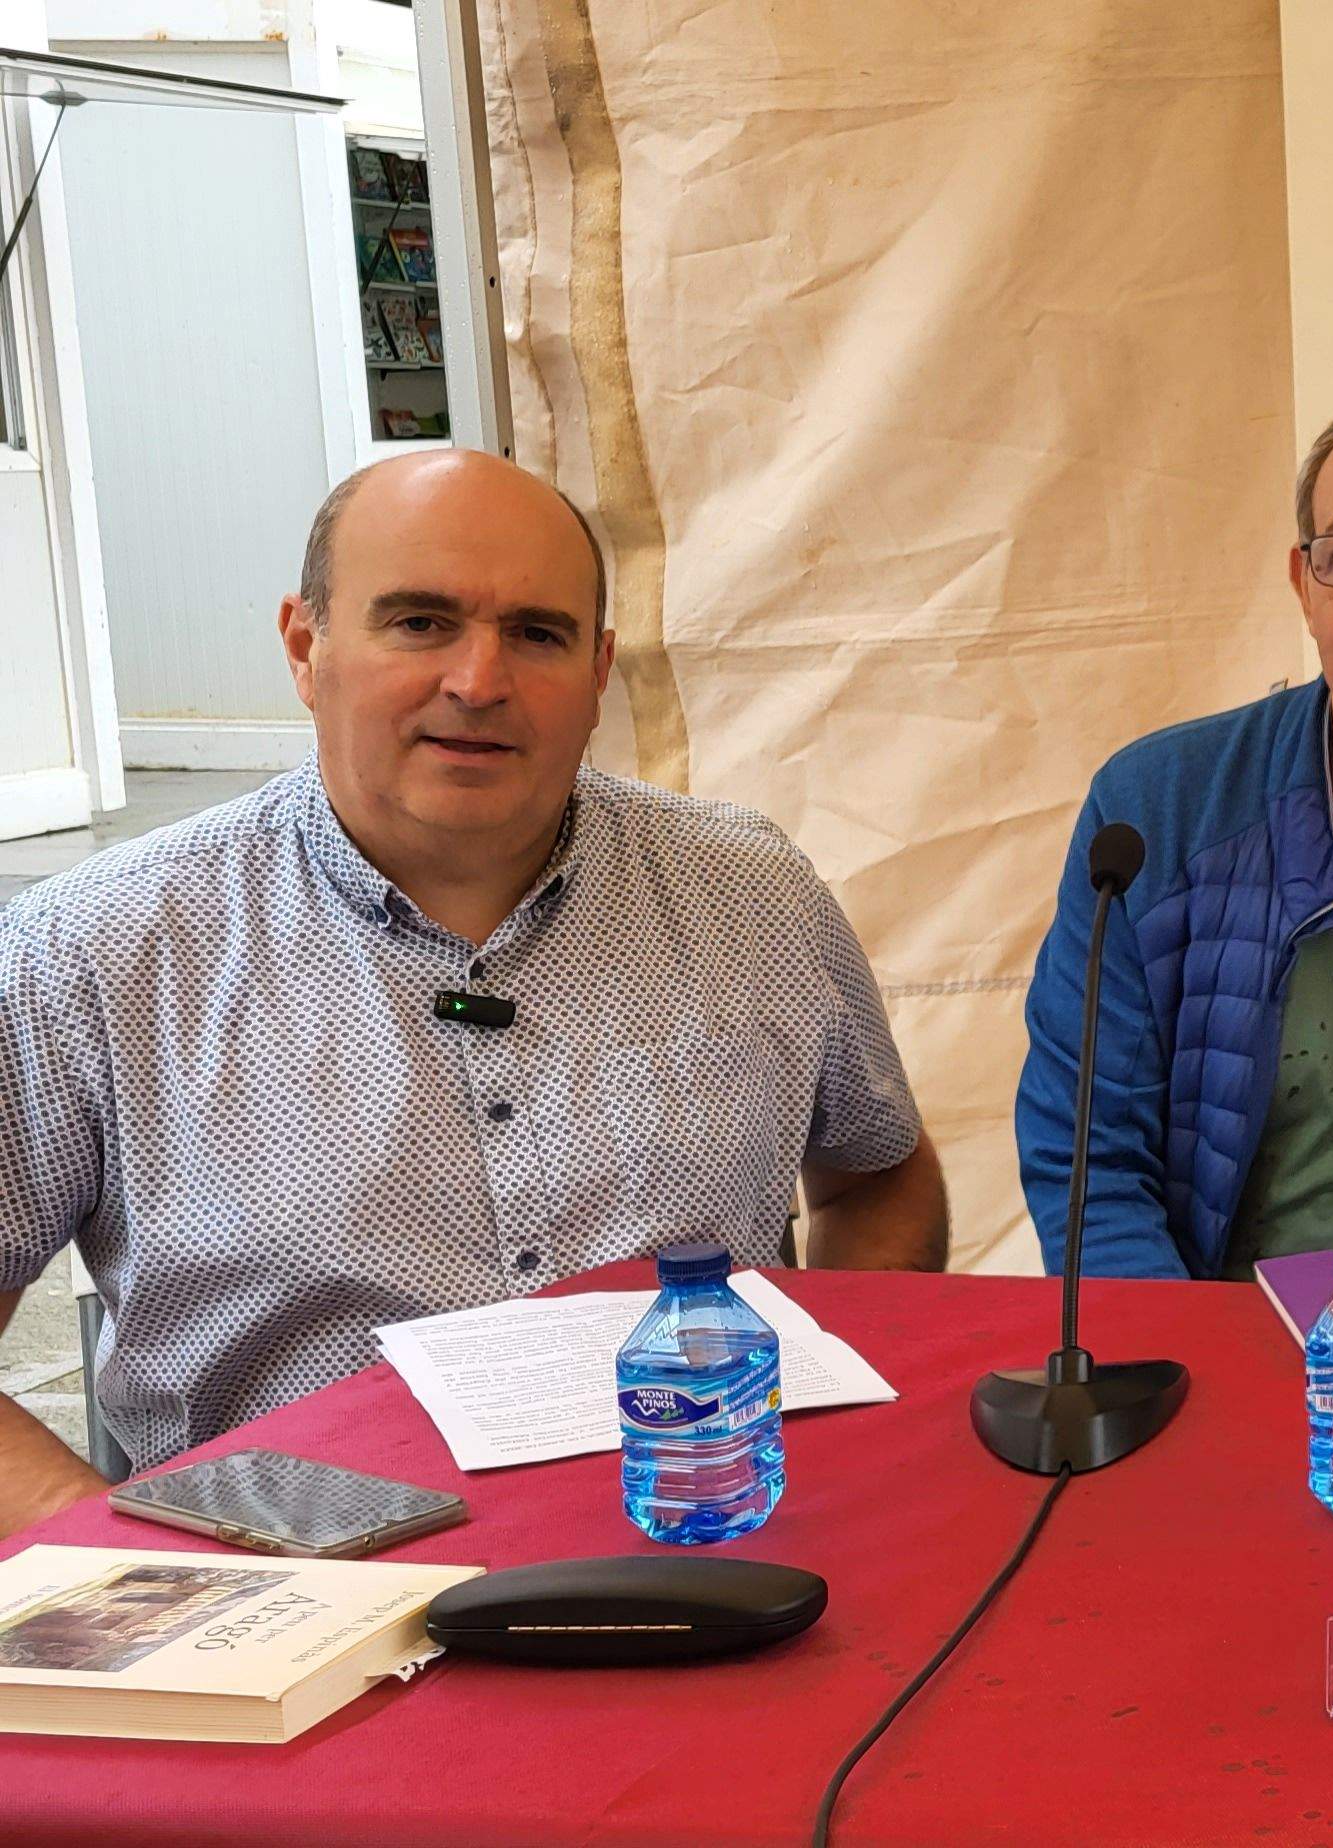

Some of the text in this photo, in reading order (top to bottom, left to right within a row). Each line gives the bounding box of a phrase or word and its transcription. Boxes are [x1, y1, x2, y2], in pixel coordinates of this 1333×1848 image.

[637, 1389, 677, 1401] MONTE
[643, 1398, 677, 1410] PINOS
[194, 1591, 319, 1651] Aragó
